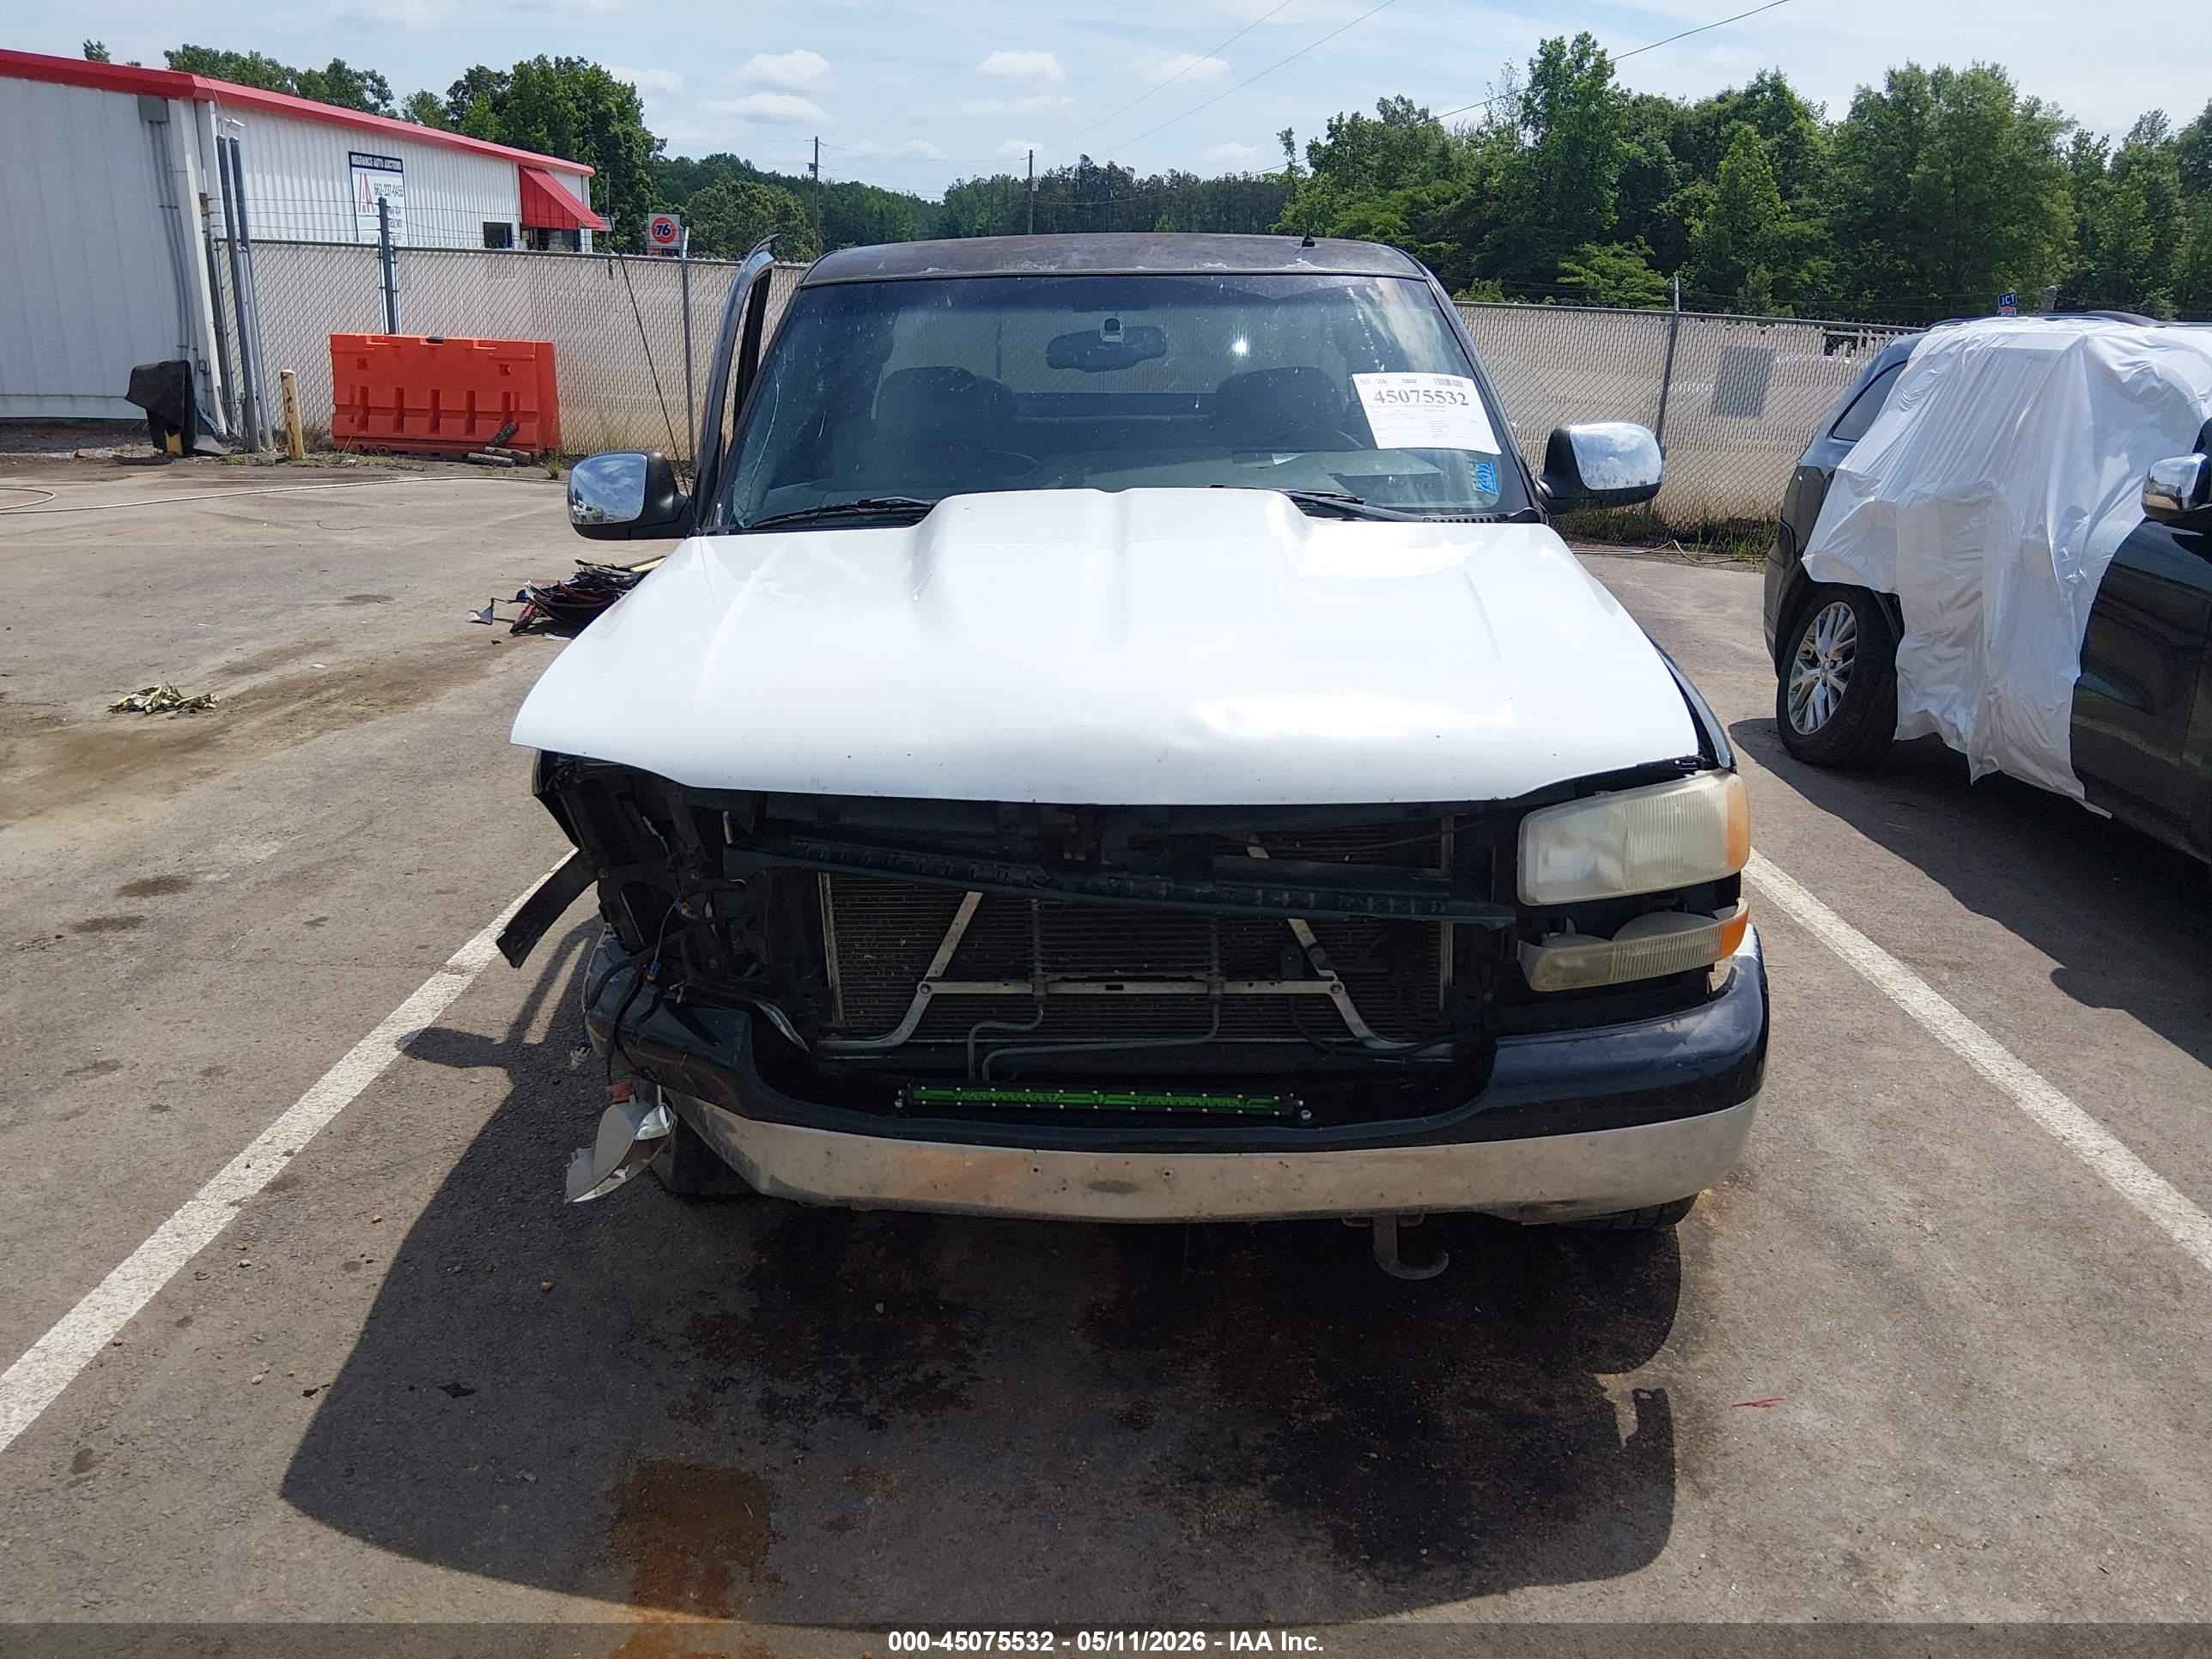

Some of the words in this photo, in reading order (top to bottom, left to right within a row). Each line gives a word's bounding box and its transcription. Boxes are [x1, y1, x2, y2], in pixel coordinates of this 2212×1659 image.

[350, 155, 373, 167] INSURANCE
[374, 157, 384, 168] AUTO
[655, 222, 672, 237] 76
[2002, 294, 2014, 305] JCT
[1374, 389, 1469, 406] 45075532
